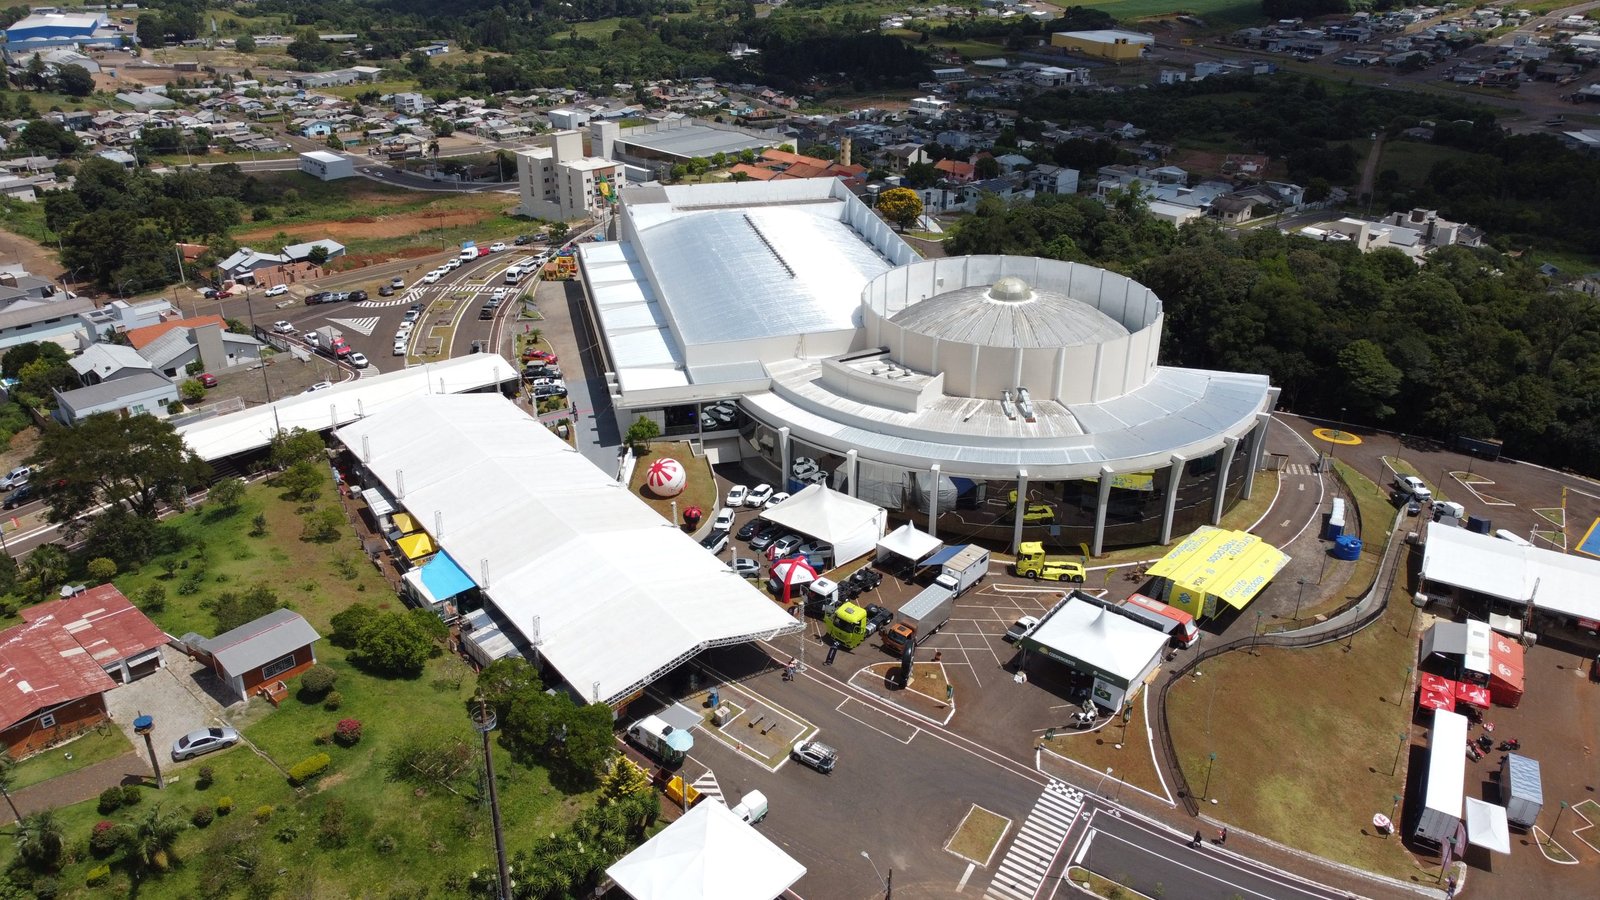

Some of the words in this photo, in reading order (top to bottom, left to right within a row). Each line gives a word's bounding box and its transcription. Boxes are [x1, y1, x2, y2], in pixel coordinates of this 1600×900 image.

[1229, 535, 1256, 556] Circuito
[1191, 576, 1208, 587] VISA
[1224, 579, 1248, 599] Circuito
